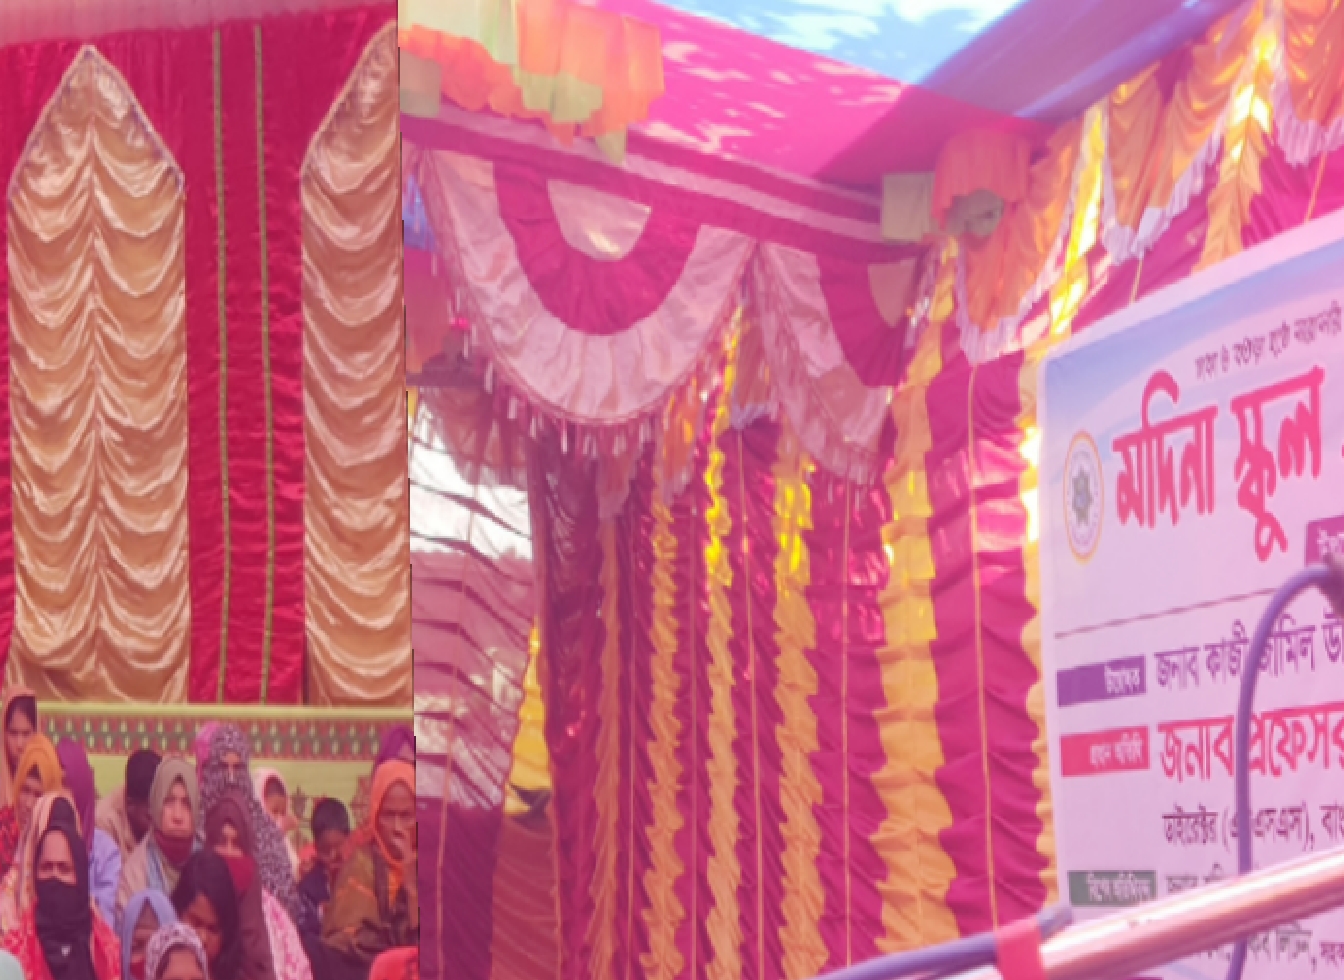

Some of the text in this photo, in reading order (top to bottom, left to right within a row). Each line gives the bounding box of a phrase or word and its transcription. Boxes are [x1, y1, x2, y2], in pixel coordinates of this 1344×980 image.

[1113, 370, 1218, 529] মদিনা
[1230, 365, 1324, 561] স্কুল
[1154, 647, 1199, 689] জনাব
[1205, 618, 1249, 681] কাজী
[1158, 714, 1235, 782] জনাব
